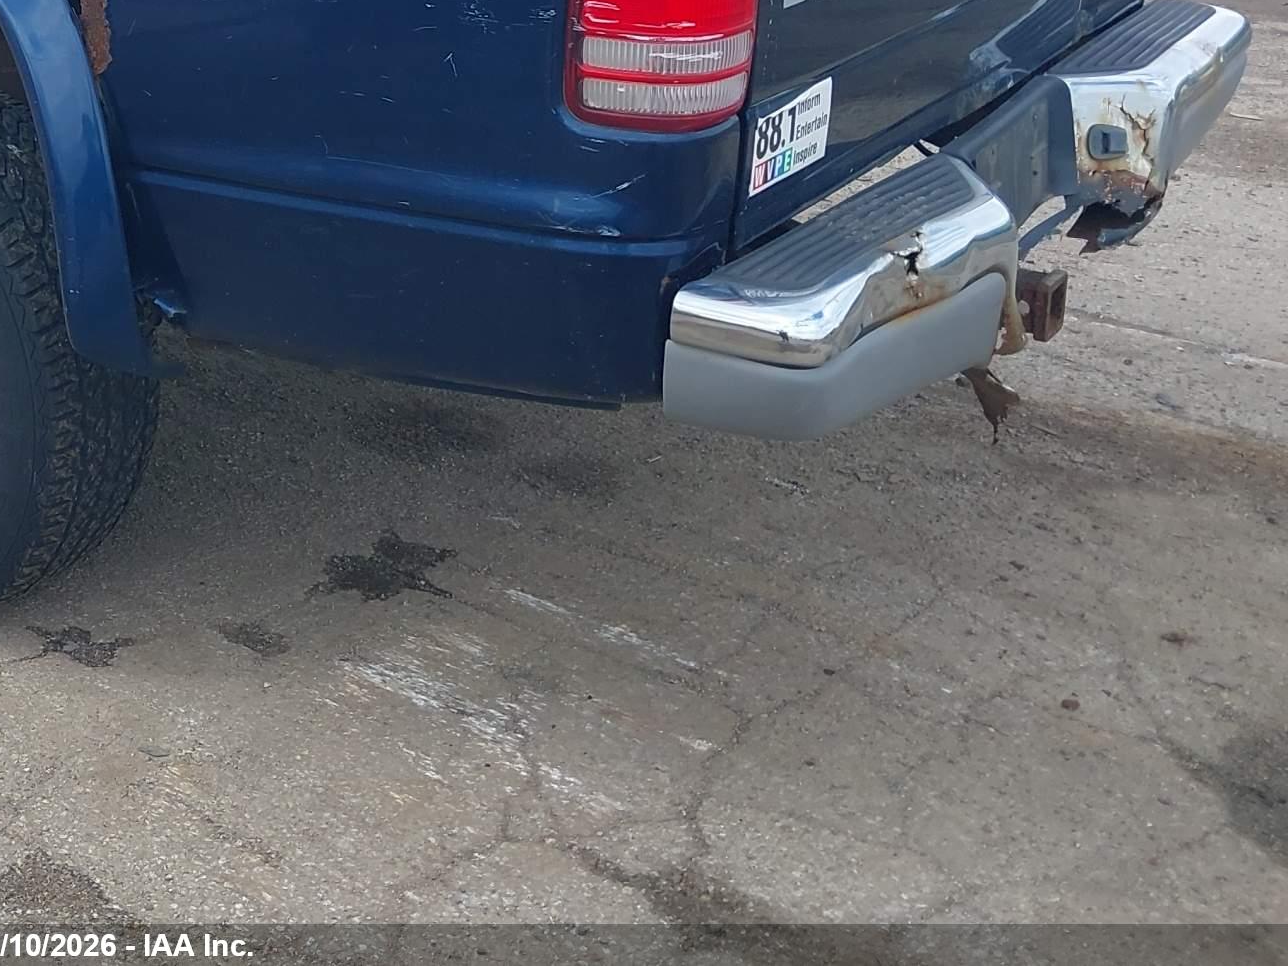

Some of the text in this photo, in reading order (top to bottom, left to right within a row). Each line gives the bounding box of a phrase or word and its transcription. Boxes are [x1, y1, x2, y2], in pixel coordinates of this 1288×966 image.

[755, 105, 797, 160] 88.1
[796, 112, 828, 141] Entertain
[754, 149, 792, 190] WVPE
